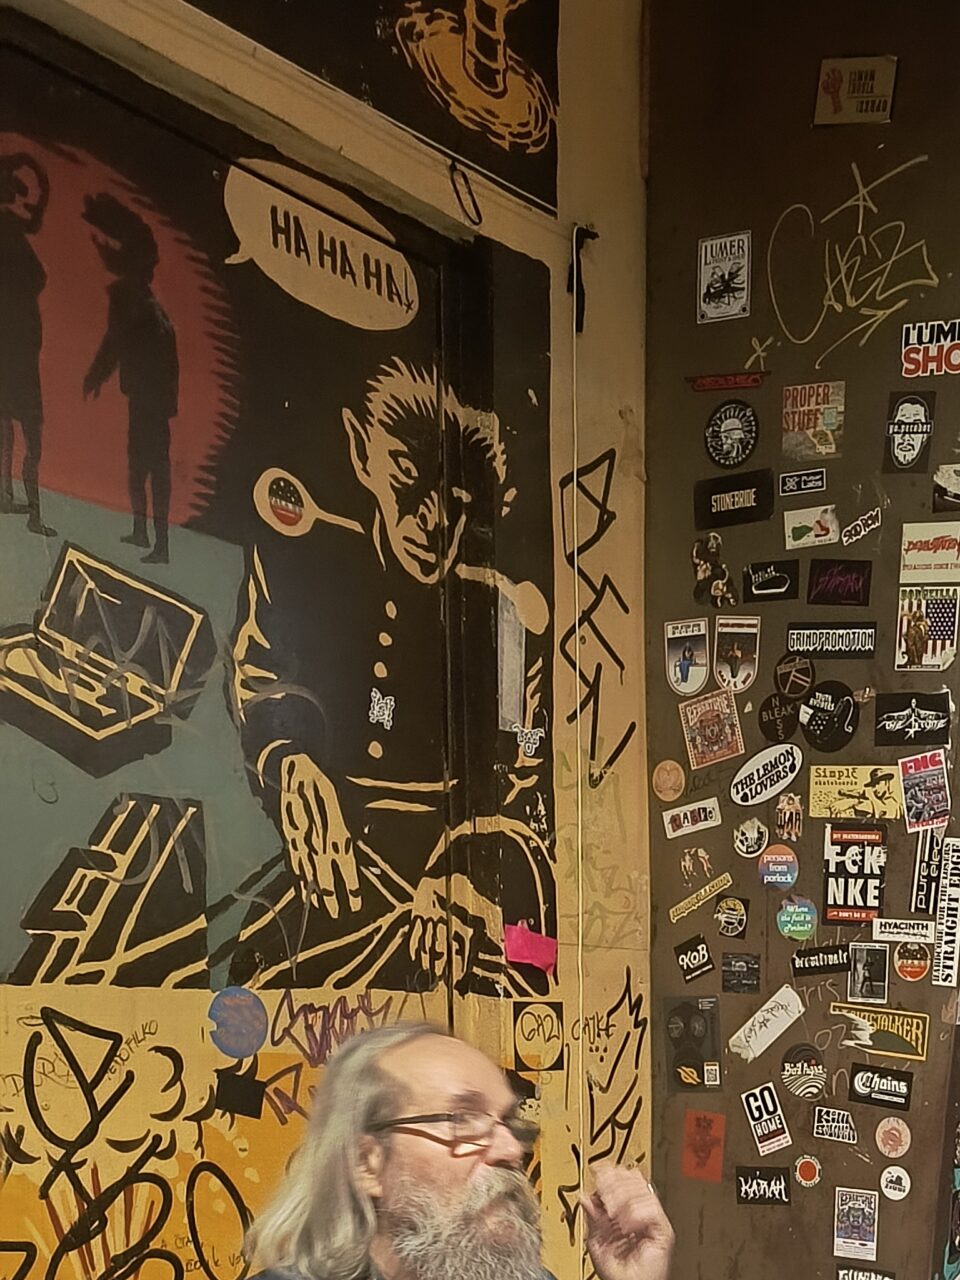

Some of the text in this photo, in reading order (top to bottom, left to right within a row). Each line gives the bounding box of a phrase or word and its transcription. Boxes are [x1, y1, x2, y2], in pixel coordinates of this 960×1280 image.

[270, 205, 415, 312] HA HA HA!
[704, 239, 745, 265] LUMER
[784, 384, 831, 408] PROPER
[784, 408, 822, 432] STUFF
[711, 489, 757, 512] STONEBRIDE
[861, 508, 881, 532] ROW
[788, 630, 875, 651] GRINDPROMOTION
[733, 746, 796, 795] THE LEMON
[749, 765, 788, 800] LOVERS
[814, 768, 858, 780] Simple
[769, 863, 787, 872] from
[827, 845, 882, 874] FCK
[827, 877, 881, 907] NKE
[917, 862, 928, 908] pure
[933, 843, 952, 983] HARDCORE FOR THE LOSERS
[879, 921, 929, 932] HYACINTH
[941, 893, 960, 984] STRAIGHT
[679, 944, 708, 970] KOB
[854, 1069, 909, 1095] Chains
[745, 1085, 778, 1122] GO
[755, 1116, 783, 1138] HOME
